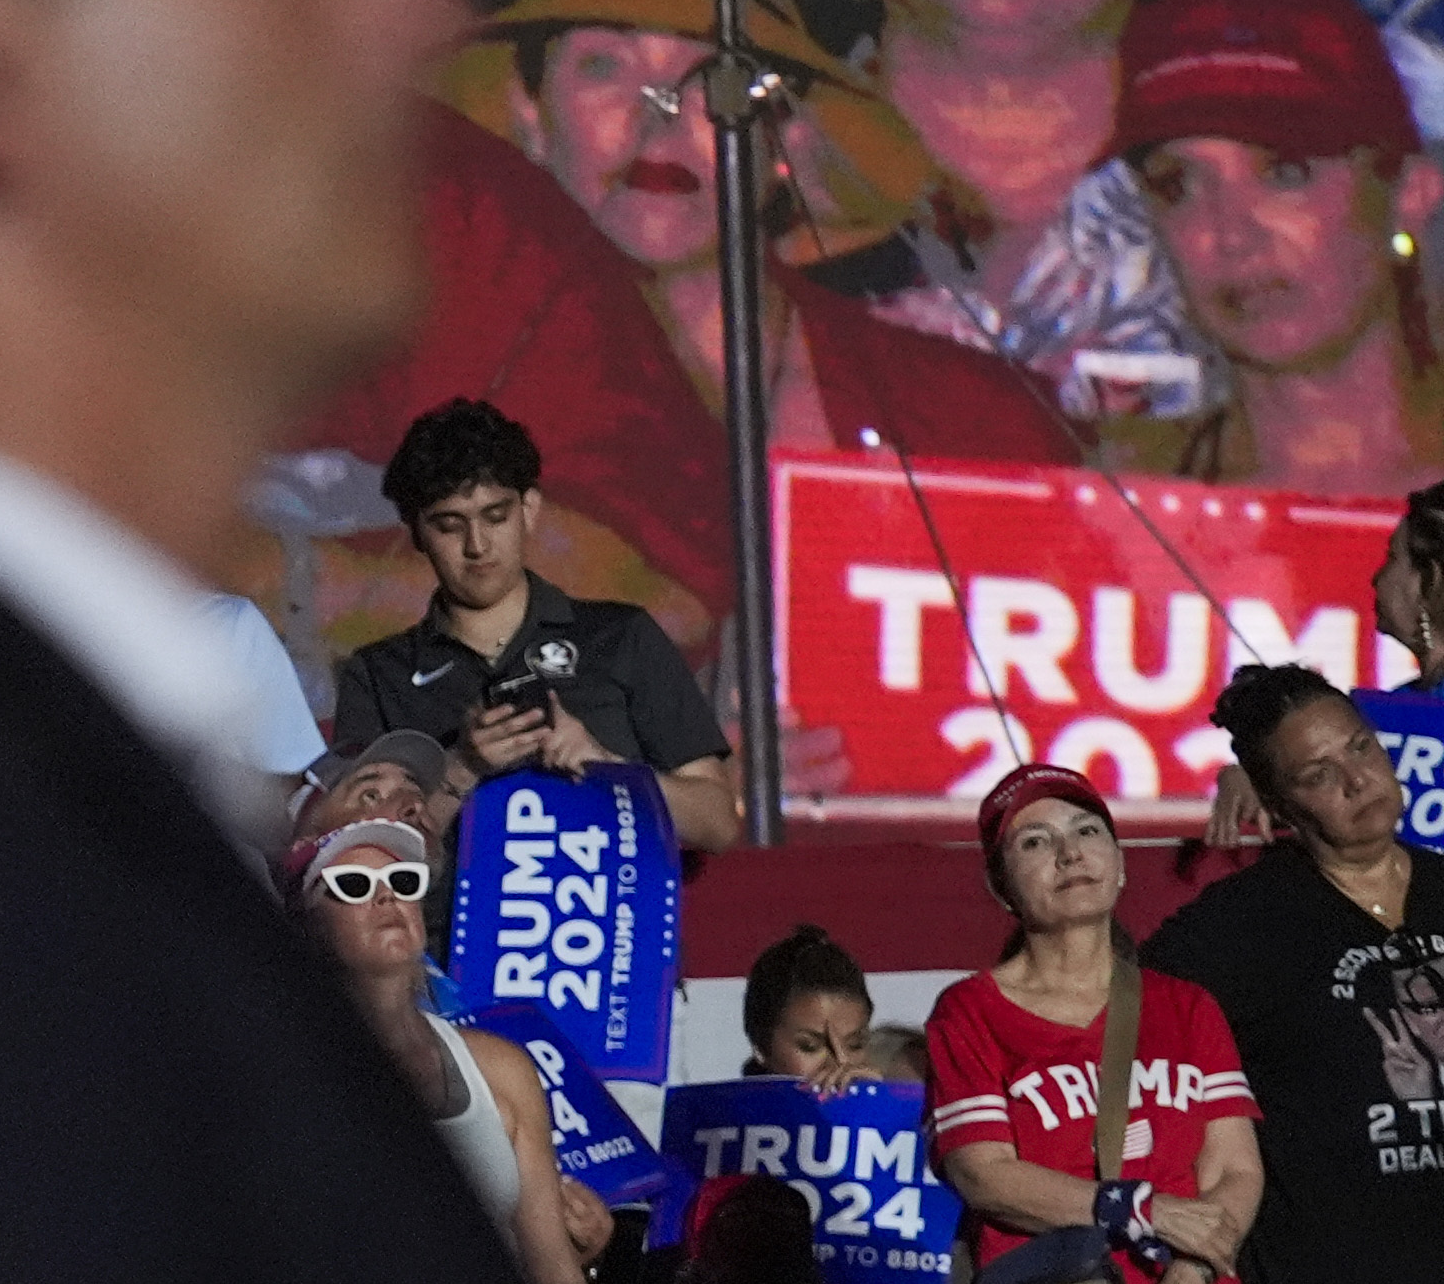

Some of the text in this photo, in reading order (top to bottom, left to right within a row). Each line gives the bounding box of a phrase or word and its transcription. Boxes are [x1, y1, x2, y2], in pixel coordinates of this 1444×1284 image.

[616, 863, 638, 897] TO
[547, 824, 611, 1012] 2024
[610, 902, 635, 987] TRUMP
[843, 1245, 879, 1266] TO
